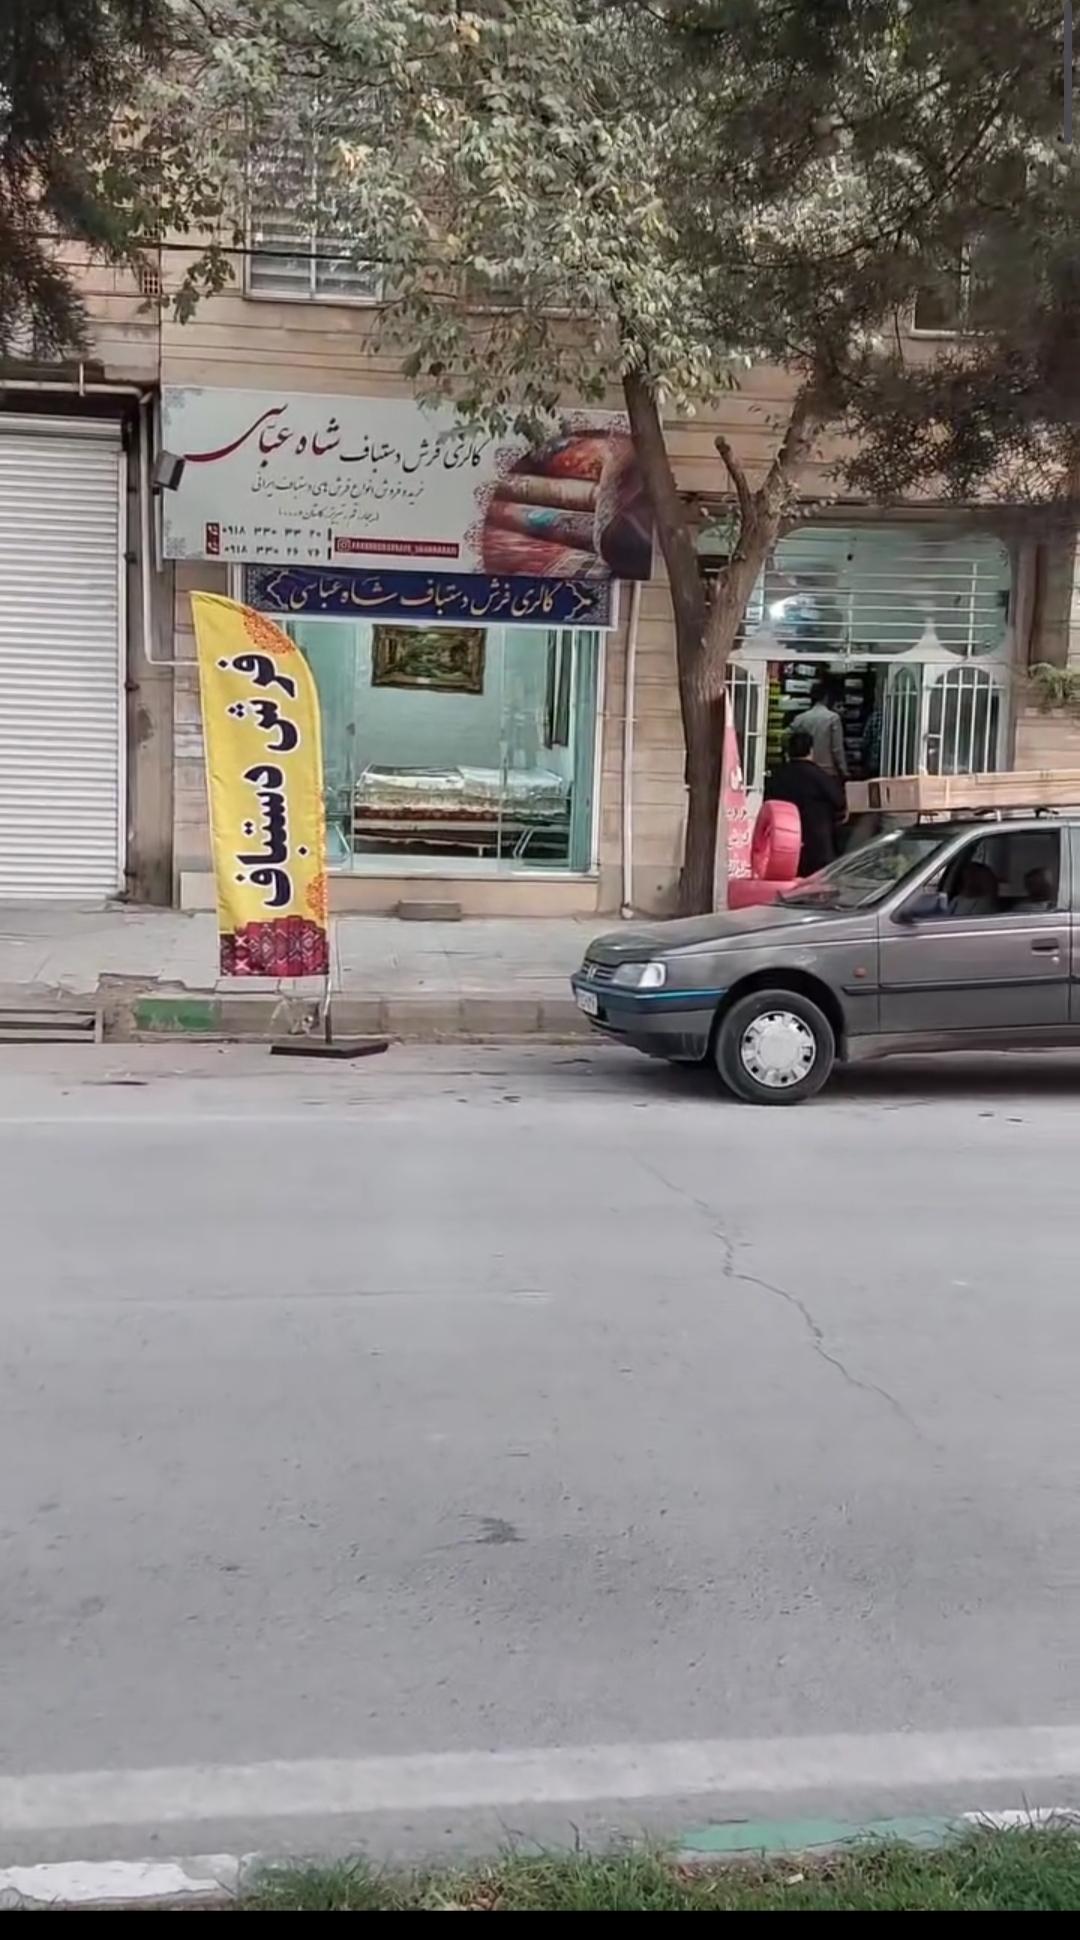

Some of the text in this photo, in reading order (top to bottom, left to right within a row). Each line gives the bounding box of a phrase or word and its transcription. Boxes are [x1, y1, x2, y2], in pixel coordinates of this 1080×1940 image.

[295, 417, 341, 456] شاه
[339, 435, 401, 473] دستباف
[402, 438, 440, 473] فرش
[222, 525, 246, 536] ۰۹۱۸
[224, 544, 248, 555] ۰۹۱۸
[289, 577, 343, 609] عباسی
[339, 576, 399, 607] شاه
[400, 579, 469, 616] دستباف
[470, 578, 511, 616] فرش
[217, 652, 308, 908] فرش دستباف
